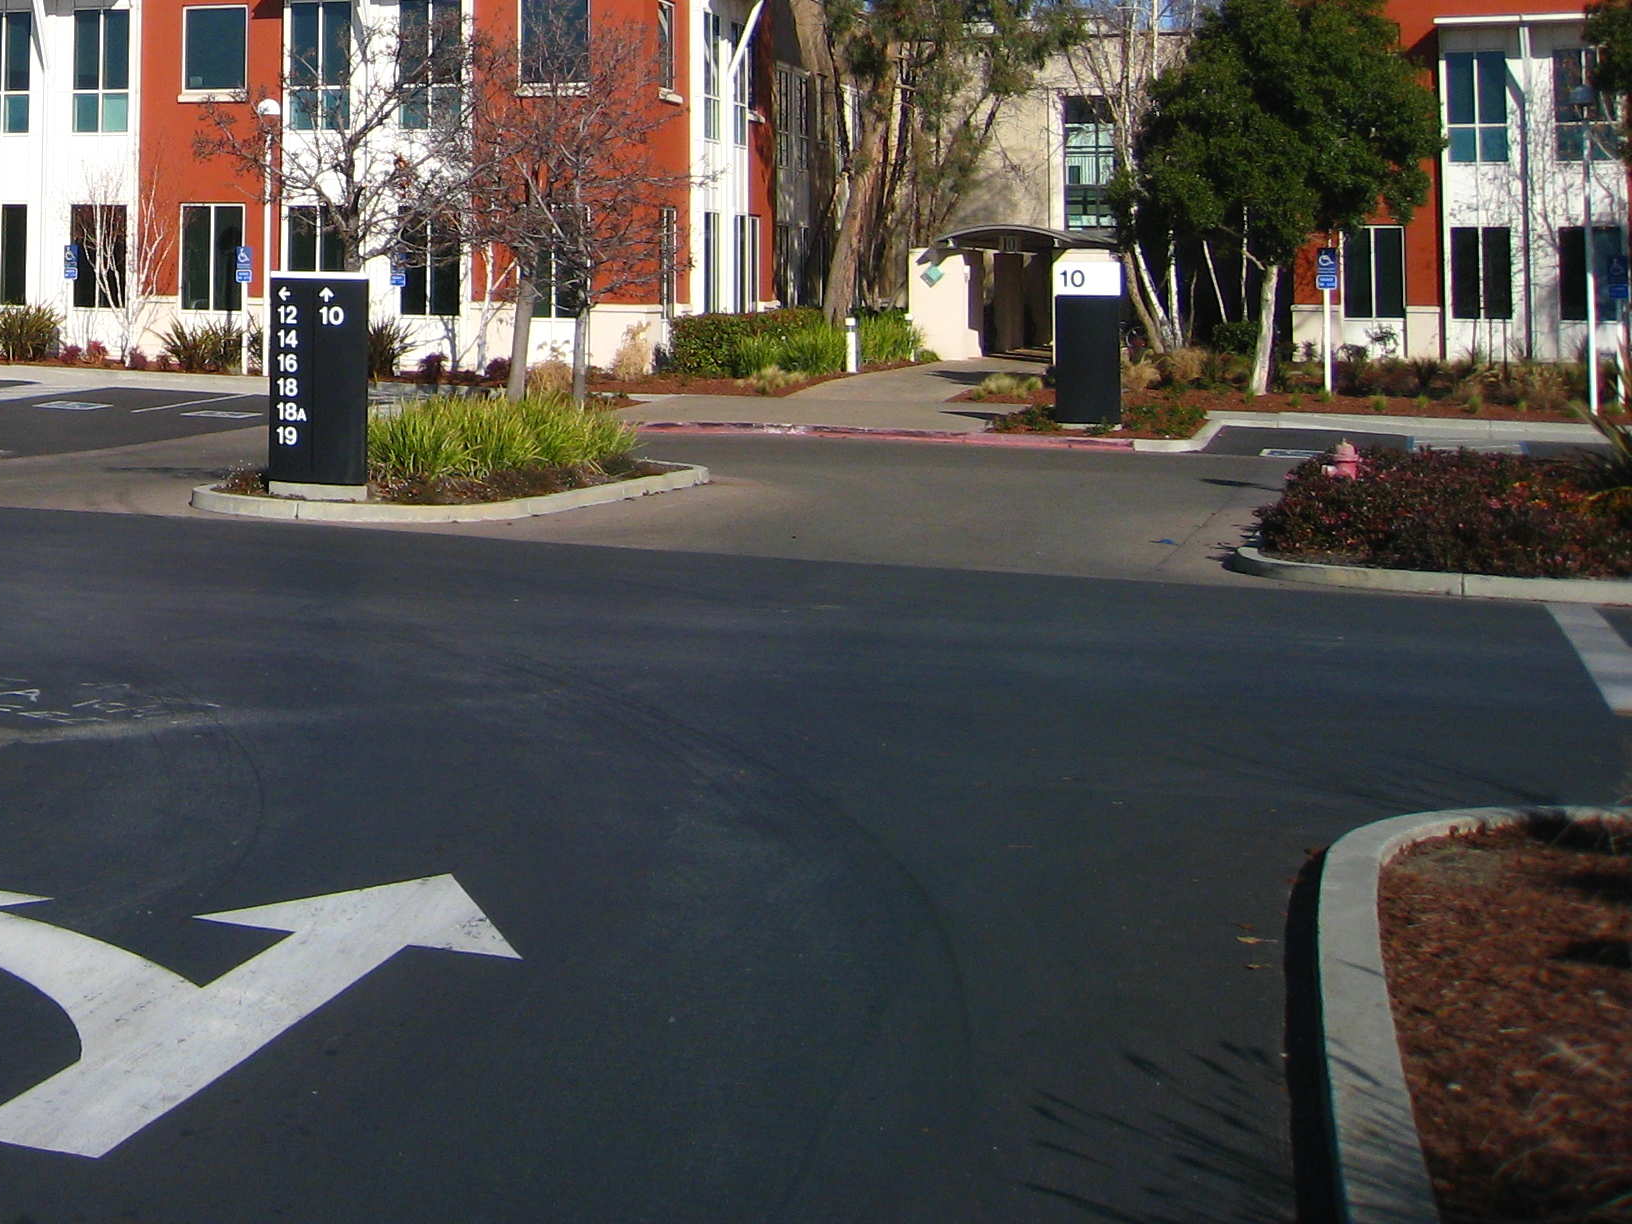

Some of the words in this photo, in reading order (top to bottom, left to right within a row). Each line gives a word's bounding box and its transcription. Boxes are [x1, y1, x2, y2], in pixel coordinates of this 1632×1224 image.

[1059, 269, 1085, 288] 10
[277, 305, 298, 325] 12
[318, 305, 345, 326] 10
[277, 329, 299, 349] 14
[277, 353, 298, 373] 16
[276, 377, 299, 397] 18
[276, 401, 307, 422] 18A
[276, 425, 298, 446] 19
